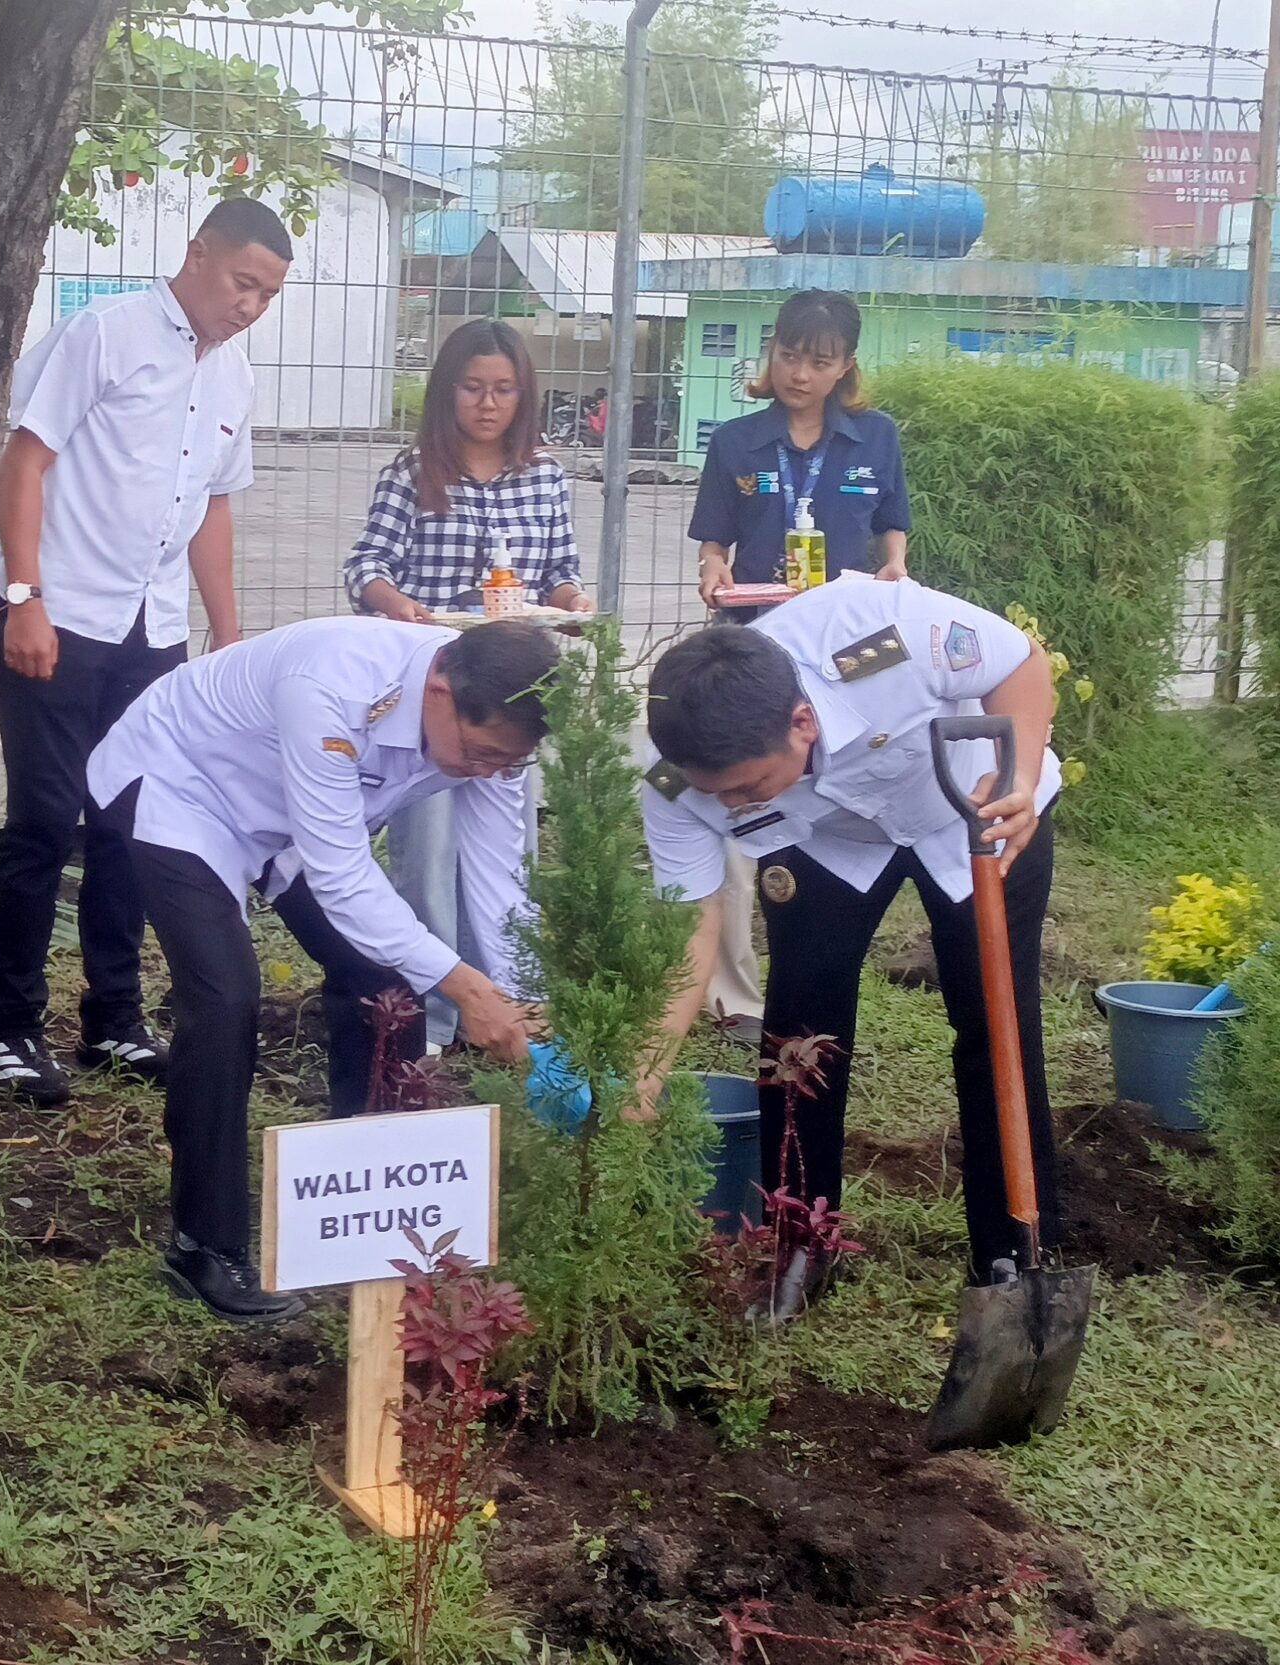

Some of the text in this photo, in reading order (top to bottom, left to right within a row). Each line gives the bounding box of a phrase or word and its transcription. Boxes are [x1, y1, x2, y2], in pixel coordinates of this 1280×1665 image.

[1213, 147, 1252, 164] DOA
[293, 1159, 468, 1200] WALI KOTA
[319, 1204, 442, 1240] BITUNG
